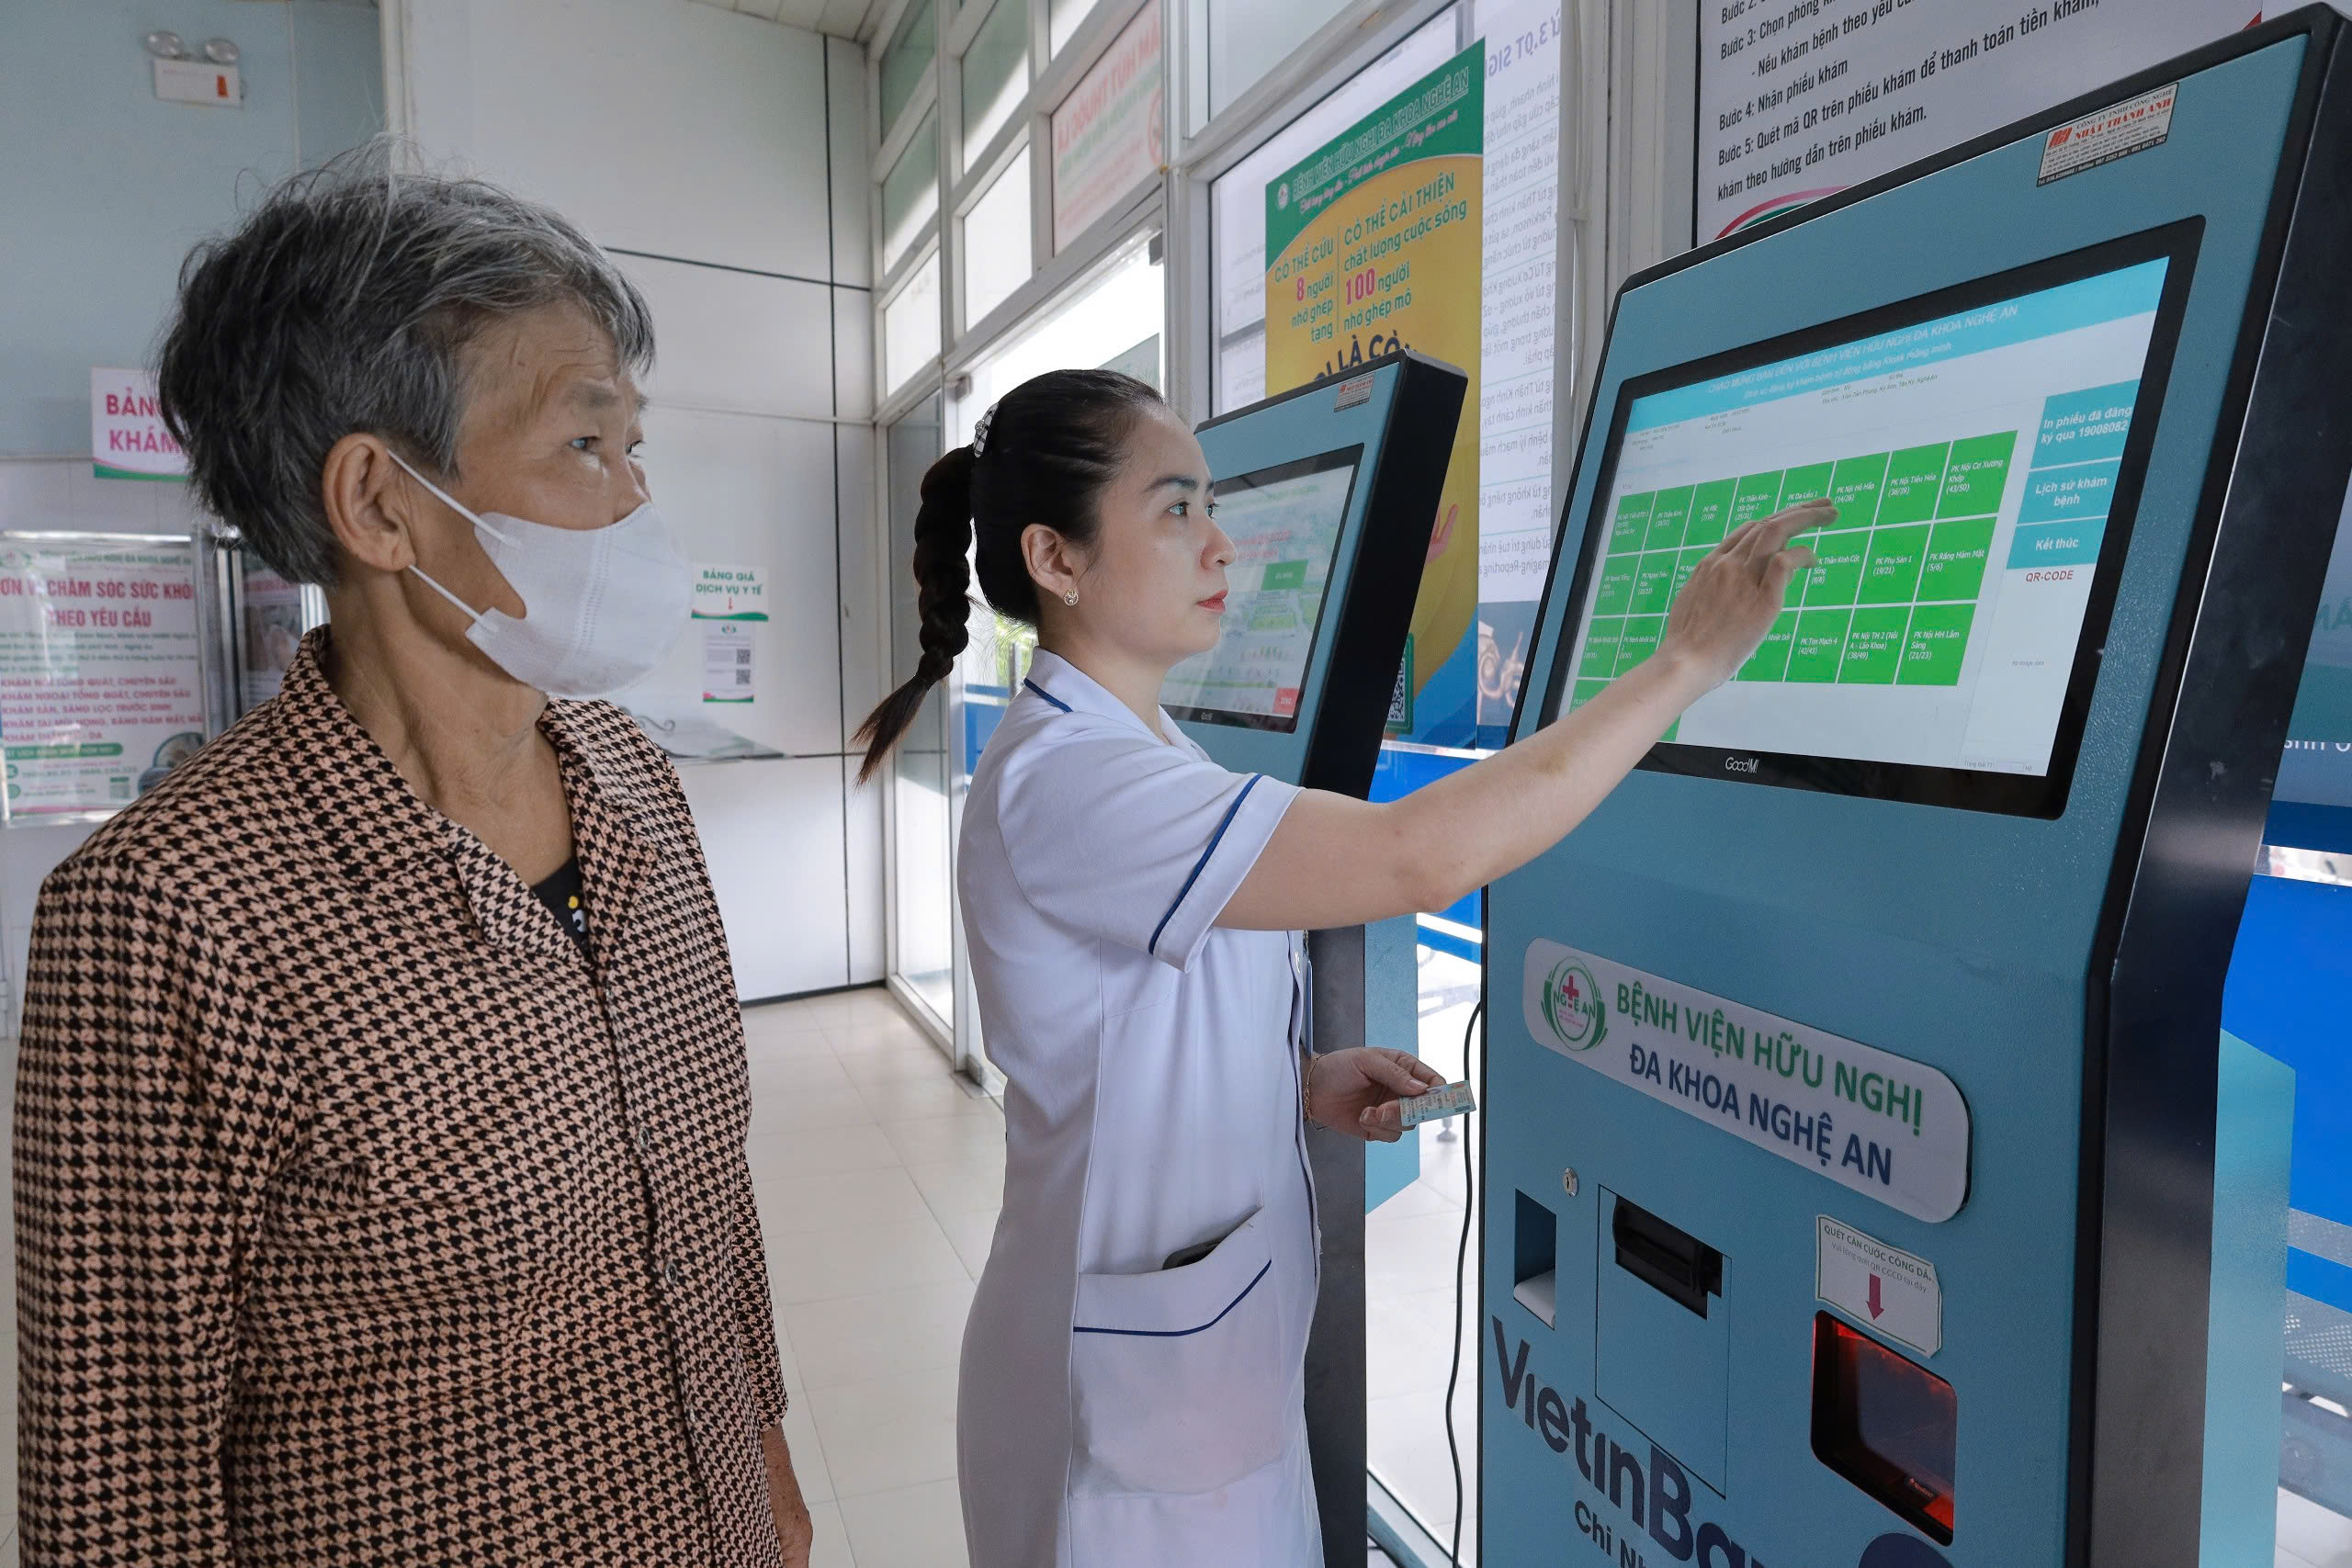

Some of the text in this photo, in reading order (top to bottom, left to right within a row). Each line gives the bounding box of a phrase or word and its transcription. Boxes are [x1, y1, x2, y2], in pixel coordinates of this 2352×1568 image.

[1721, 1, 1819, 60] Bước 3: Chọn phòng
[1758, 0, 1893, 77] Nếu khám bệnh theo yêu
[1394, 98, 1421, 133] KHOA
[1422, 74, 1453, 112] NGHỆ
[1453, 66, 1469, 95] AN
[1718, 8, 2047, 166] Bước 5: Quét mã QR trên phiếu khám để thanh toán tiền
[1719, 59, 1848, 131] Bước 4: Nhận phiếu khám
[2147, 97, 2172, 112] ANH
[1717, 106, 1927, 201] khám theo hướng dẫn trên phiếu khám.
[1344, 172, 1454, 245] CÓ THỂ CẢI THIỆN
[1311, 236, 1333, 264] CỨU
[1344, 198, 1467, 272] chất lượng cuộc sống
[1296, 272, 1333, 301] 8 người
[1346, 261, 1410, 306] 100 người
[1364, 299, 1392, 325] ghép
[1394, 288, 1412, 310] mô
[1931, 320, 1962, 336] KHOA
[1999, 304, 2018, 318] AN
[1338, 330, 1416, 370] LÀ CÒ
[106, 386, 163, 417] BẢN
[2044, 405, 2132, 429] In phiếu đã đăng
[2041, 420, 2129, 446] ký qua 19008082
[1960, 462, 1972, 472] Nội
[1973, 460, 1983, 470] Cơ
[1946, 483, 1971, 495] (43/50)
[2036, 477, 2108, 496] Lịch sử khám
[2053, 493, 2080, 507] bệnh
[1929, 553, 1939, 561] PK
[1939, 551, 1954, 561] Răng
[1956, 550, 1971, 559] Hàm
[2035, 536, 2079, 551] Kết thúc
[1883, 557, 1895, 566] Phụ
[1927, 562, 1943, 572] (5/6)
[2025, 570, 2075, 583] QR-CODE
[742, 586, 750, 594] Y
[91, 606, 119, 627] YÊU
[1914, 631, 1921, 639] PK
[1617, 980, 1922, 1137] BỆNH VIỆN HỮU NGHỊ
[1630, 1043, 1892, 1186] ĐA KHOA NGHỆ AN
[1824, 1224, 1845, 1240] QUÉT
[1888, 1255, 1915, 1273] CÔNG
[1917, 1267, 1934, 1283] DÂ
[1831, 1242, 1842, 1252] Vui
[1842, 1248, 1857, 1261] lòng
[1870, 1262, 1881, 1272] QR
[1882, 1266, 1903, 1281] CCCD
[1575, 1499, 1611, 1556] Chi
